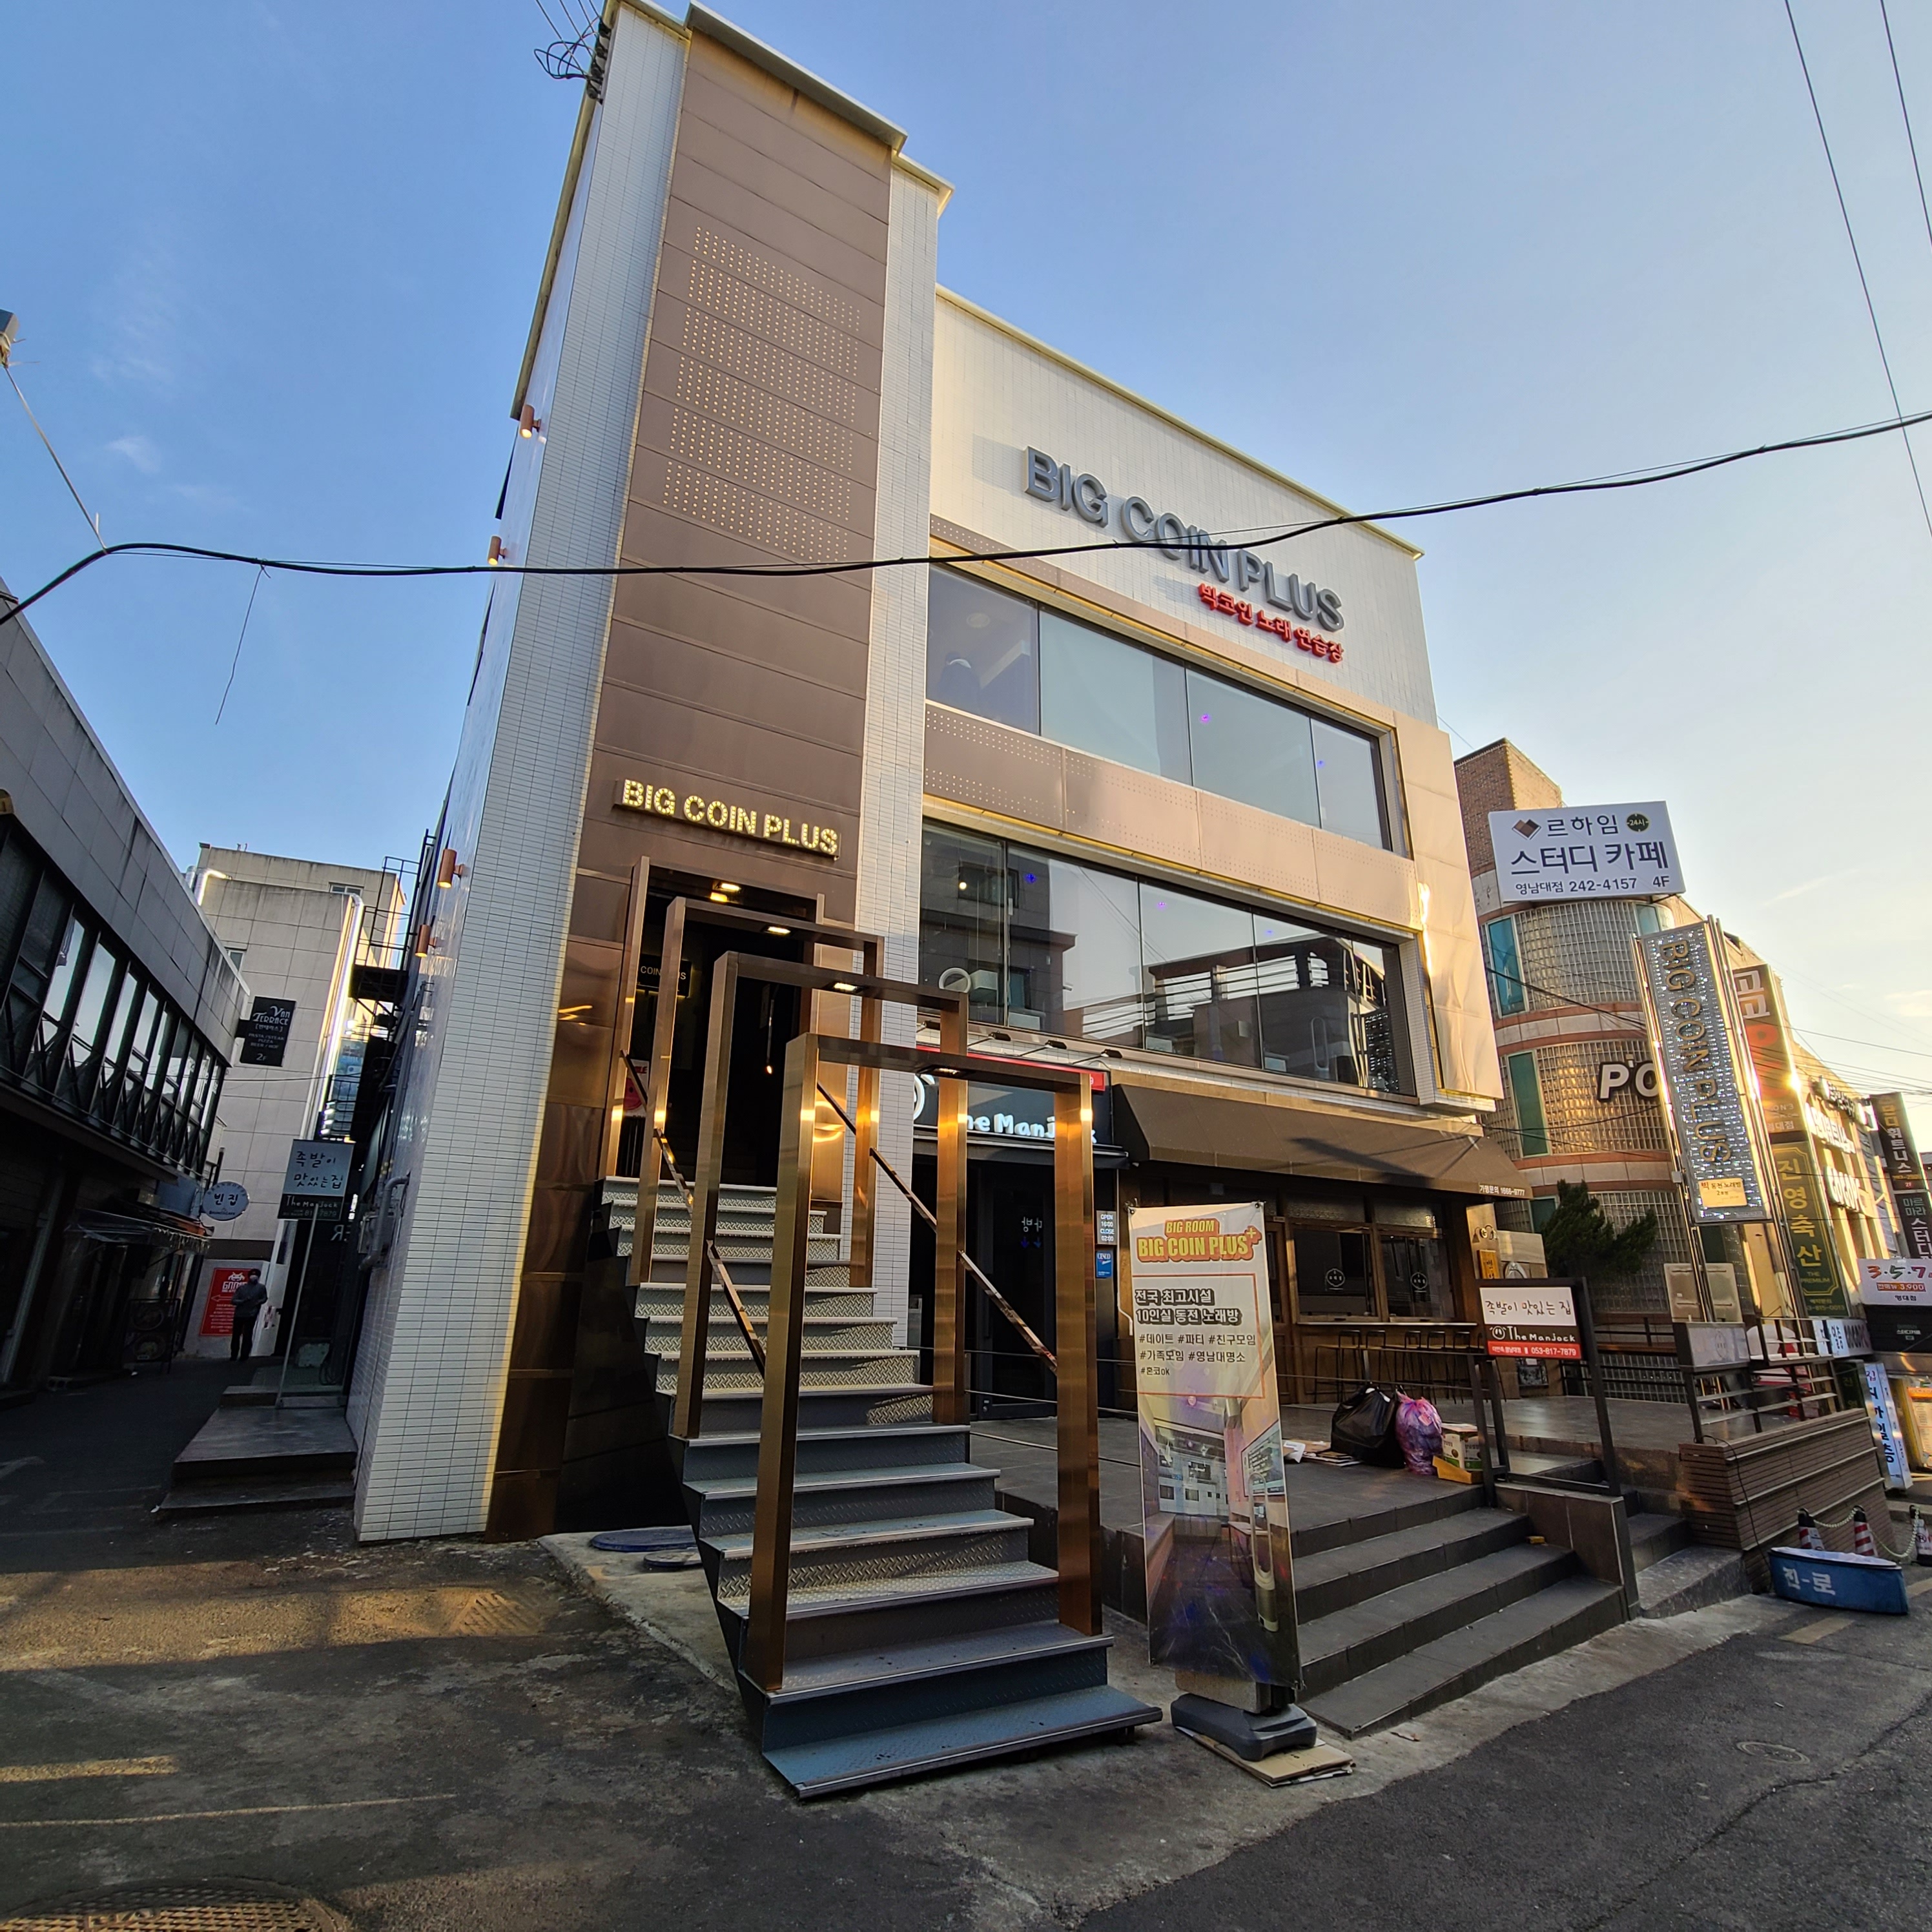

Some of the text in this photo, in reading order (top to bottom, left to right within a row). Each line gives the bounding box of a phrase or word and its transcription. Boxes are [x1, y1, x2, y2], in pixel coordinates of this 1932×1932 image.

[1024, 446, 1344, 632] BIG COIN PLUS
[1198, 583, 1344, 663] 빅코인 노래 연습장
[622, 779, 838, 854] BIG COIN PLUS
[1547, 815, 1619, 836] 르하임
[1511, 841, 1669, 875] 스터디 카페
[1516, 876, 1670, 895] 영남대점 242-4157 4F
[1660, 940, 1731, 1162] BIG COIN PLUS
[296, 1151, 336, 1167] 족발이
[1777, 1158, 1822, 1267] 진영축산
[1166, 1220, 1215, 1233] BIG ROOM
[1138, 1238, 1164, 1257] BIG
[1167, 1237, 1205, 1257] COIN
[1135, 1289, 1213, 1304] 전국 최고시설
[1136, 1308, 1239, 1323] 10인실 동전 노래방
[1485, 1300, 1571, 1315] 족발이 맛있는 집
[1139, 1333, 1255, 1345] #데이트 #파티 #친구모임
[1507, 1326, 1527, 1341] The
[1140, 1350, 1246, 1362] #가족모임 #영남대명소
[1531, 1346, 1576, 1356] 053-817-7879
